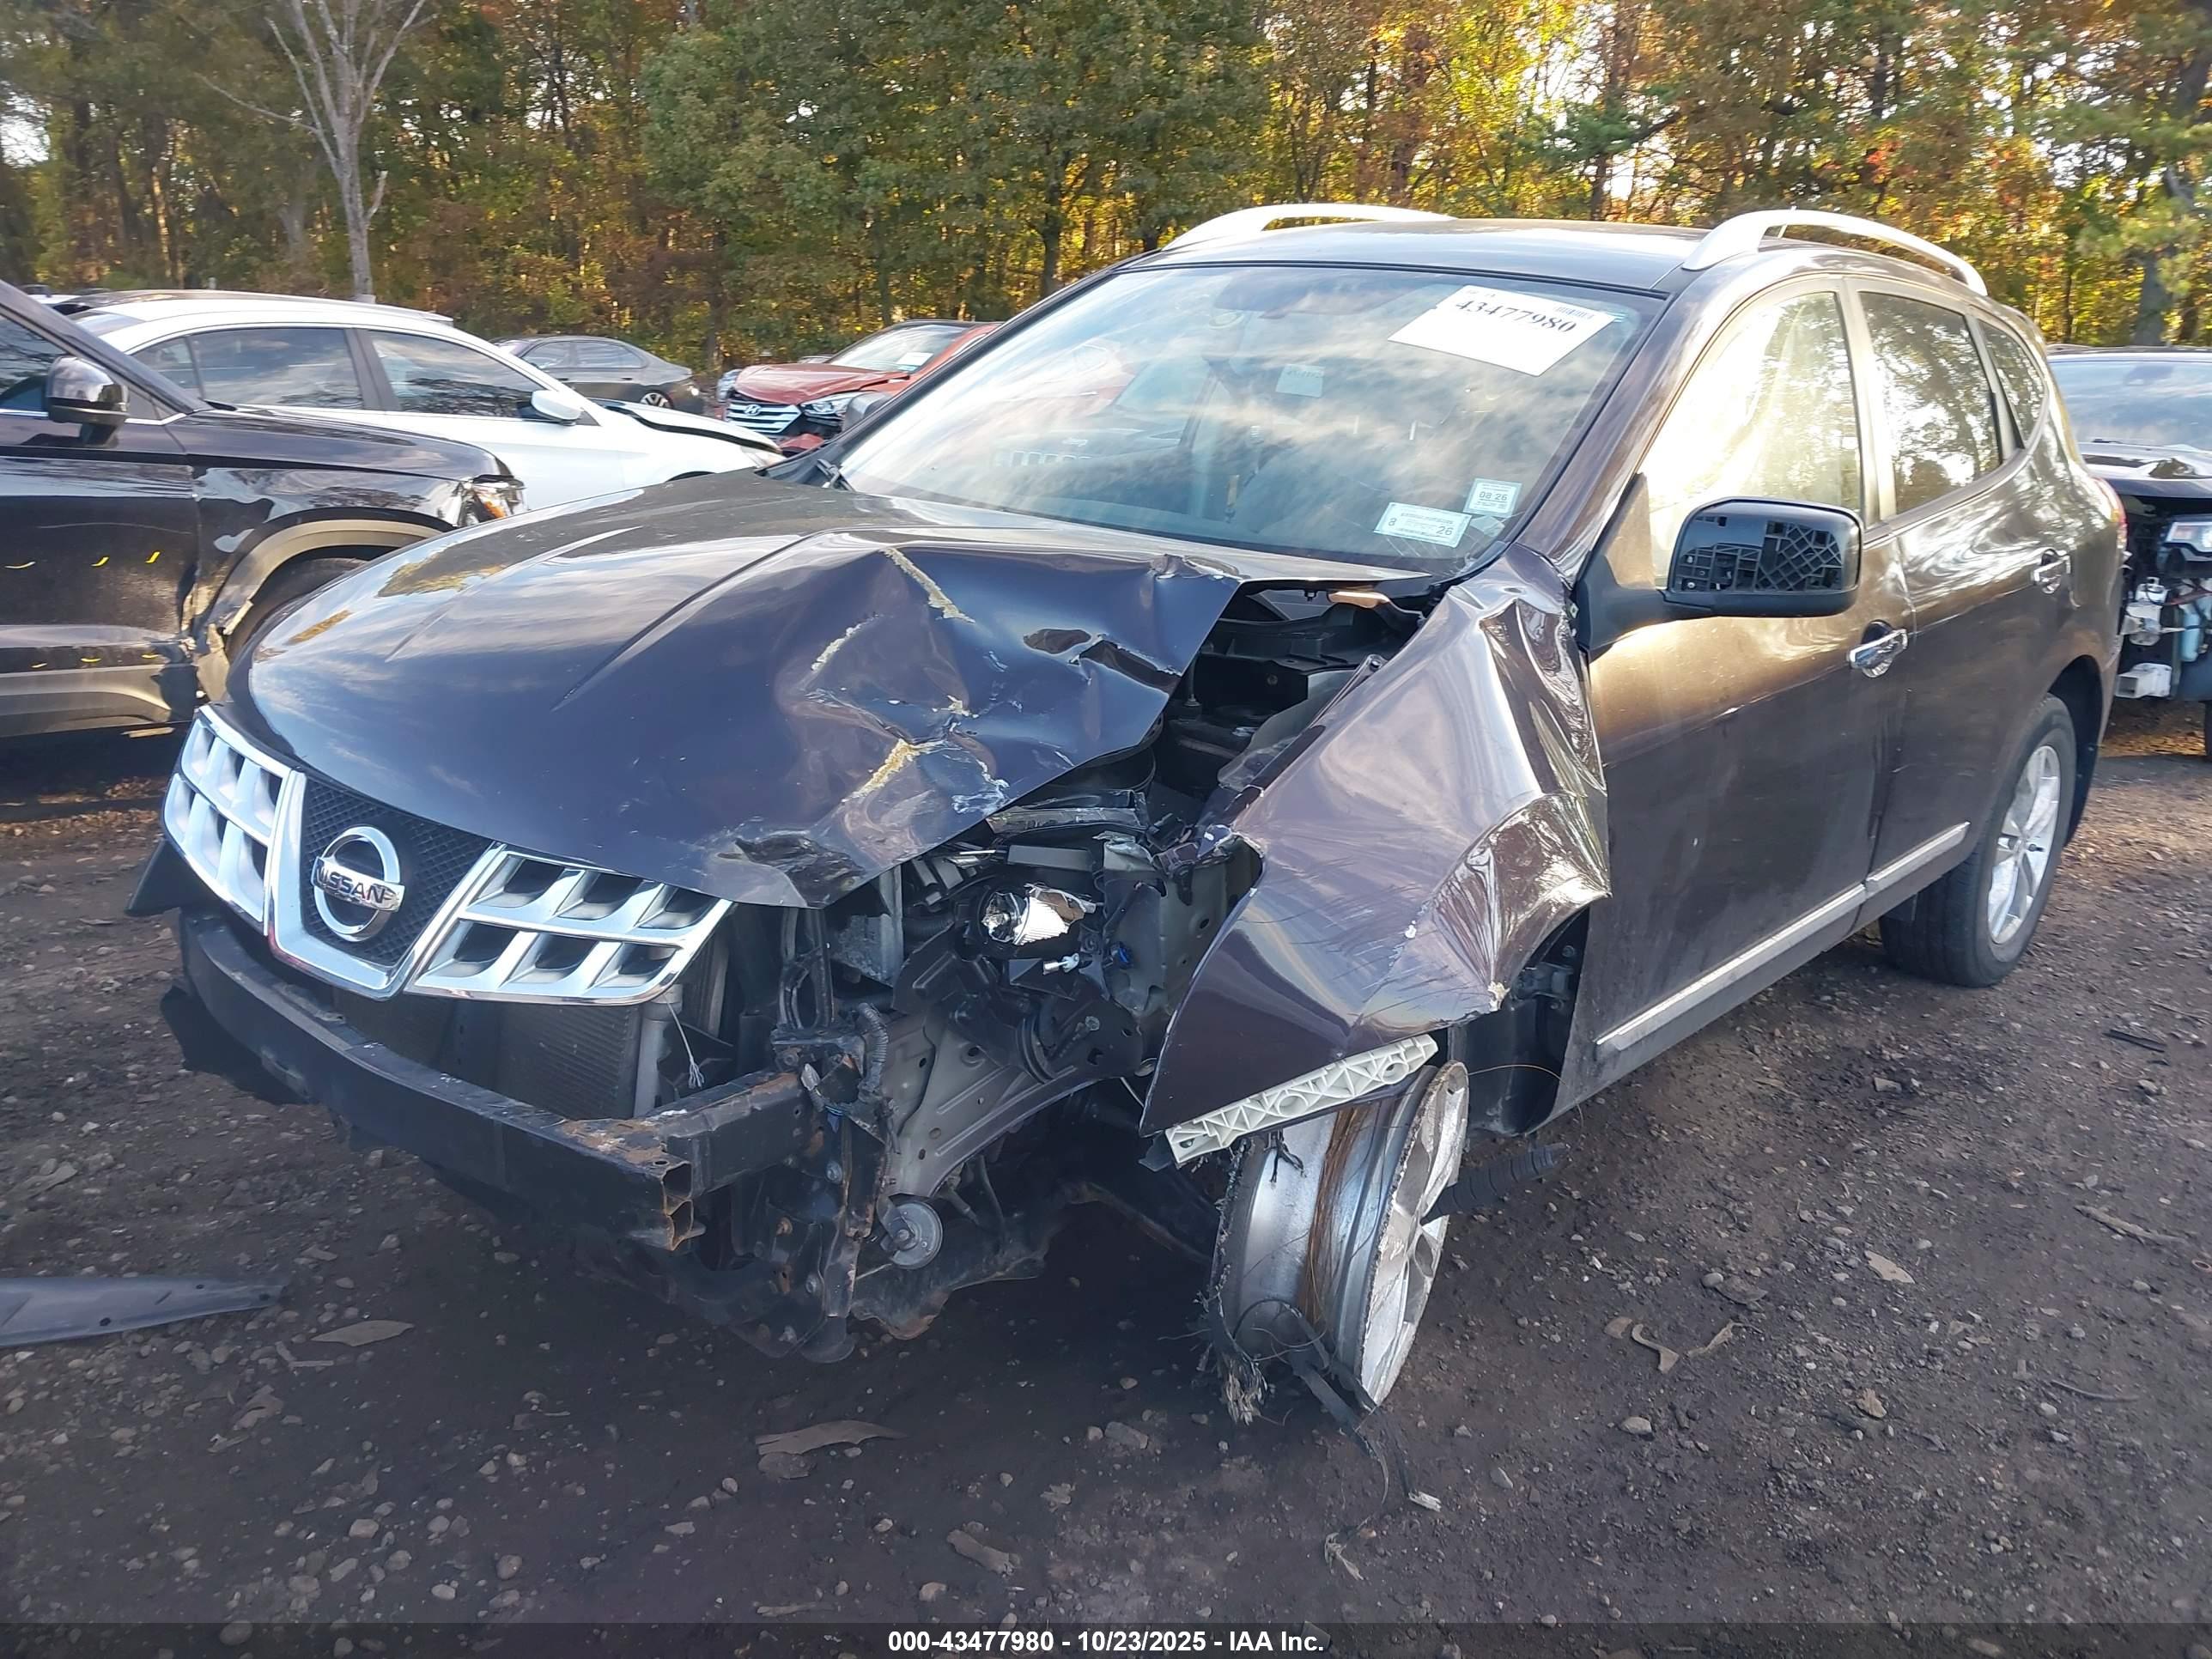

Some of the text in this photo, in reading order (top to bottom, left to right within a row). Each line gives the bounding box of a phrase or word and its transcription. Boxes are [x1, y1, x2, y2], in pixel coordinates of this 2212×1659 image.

[1455, 300, 1577, 333] 43477980
[1494, 493, 1508, 501] 26
[1436, 526, 1455, 536] 26
[316, 866, 386, 904] NISSAN
